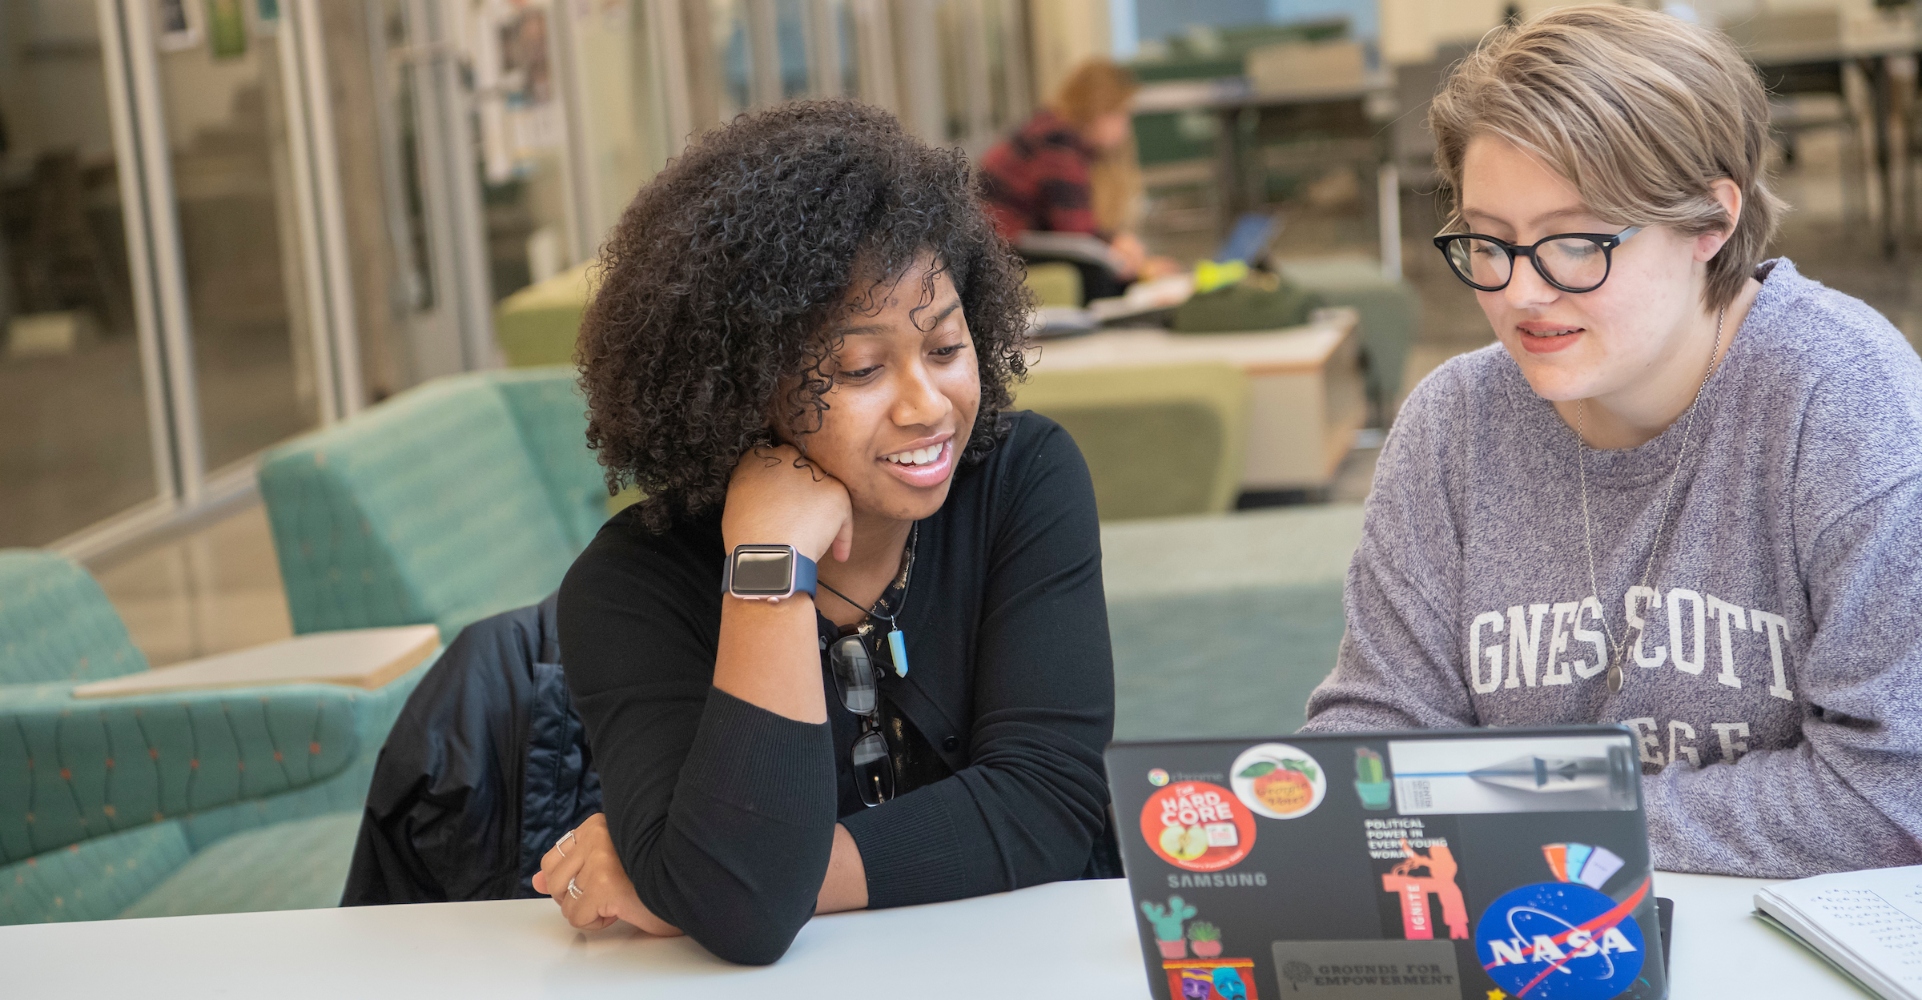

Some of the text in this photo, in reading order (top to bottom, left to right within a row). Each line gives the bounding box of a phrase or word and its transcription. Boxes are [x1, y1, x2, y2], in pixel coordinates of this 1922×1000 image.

[1625, 585, 1793, 701] SCOTT
[1161, 791, 1221, 812] HARD
[1160, 801, 1234, 827] CORE
[1364, 818, 1425, 830] POLITICAL
[1366, 829, 1423, 839] POWER IN
[1368, 837, 1448, 849] EVERY YOUNG
[1369, 850, 1414, 859] WOMAN
[1167, 872, 1268, 888] SAMSUNG
[1406, 884, 1426, 930] IGNITE
[1488, 927, 1638, 967] NASA
[1318, 963, 1442, 975] GROUNDS FOR
[1313, 974, 1454, 986] EMPOWERMENT
